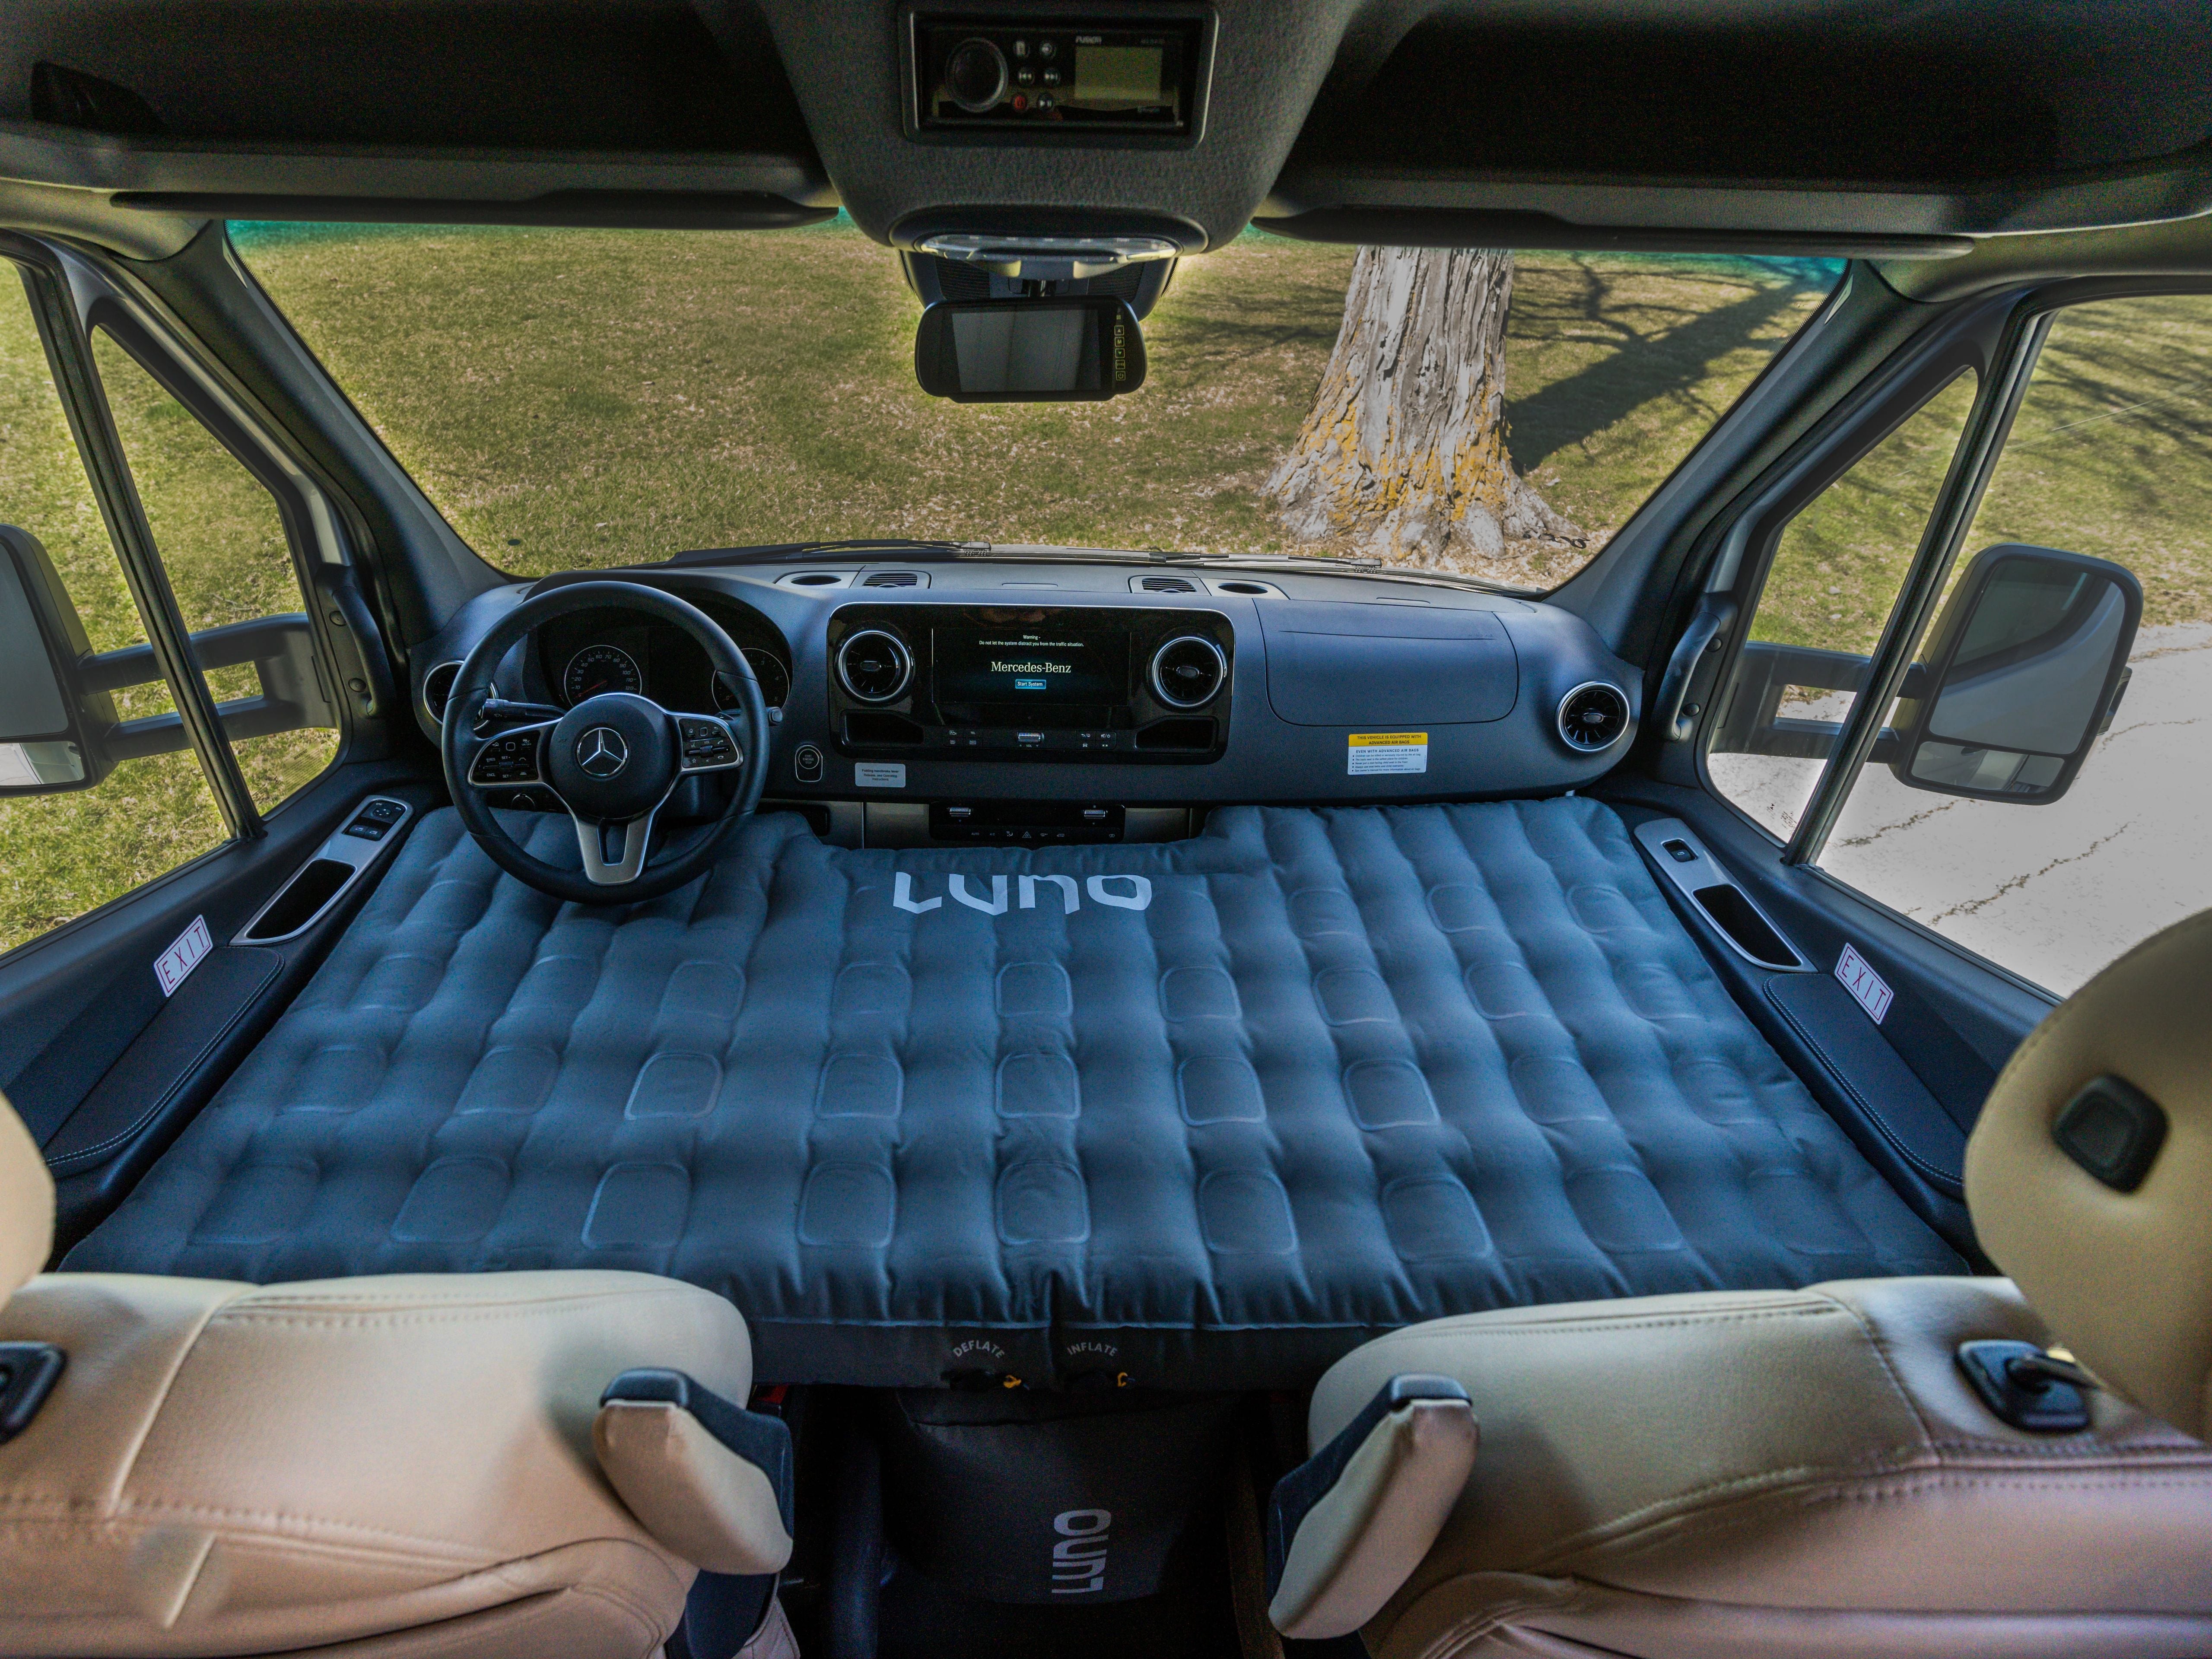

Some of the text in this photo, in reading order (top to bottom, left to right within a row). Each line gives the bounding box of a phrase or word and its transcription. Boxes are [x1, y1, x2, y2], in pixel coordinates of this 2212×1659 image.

[991, 661, 1071, 673] Mercedes-Benz
[294, 749, 308, 760] WARNING
[162, 926, 204, 985] EXIT
[1842, 954, 1886, 1011] EXIT
[952, 1340, 1005, 1359] DEFLATE
[1067, 1341, 1118, 1357] INFLATE
